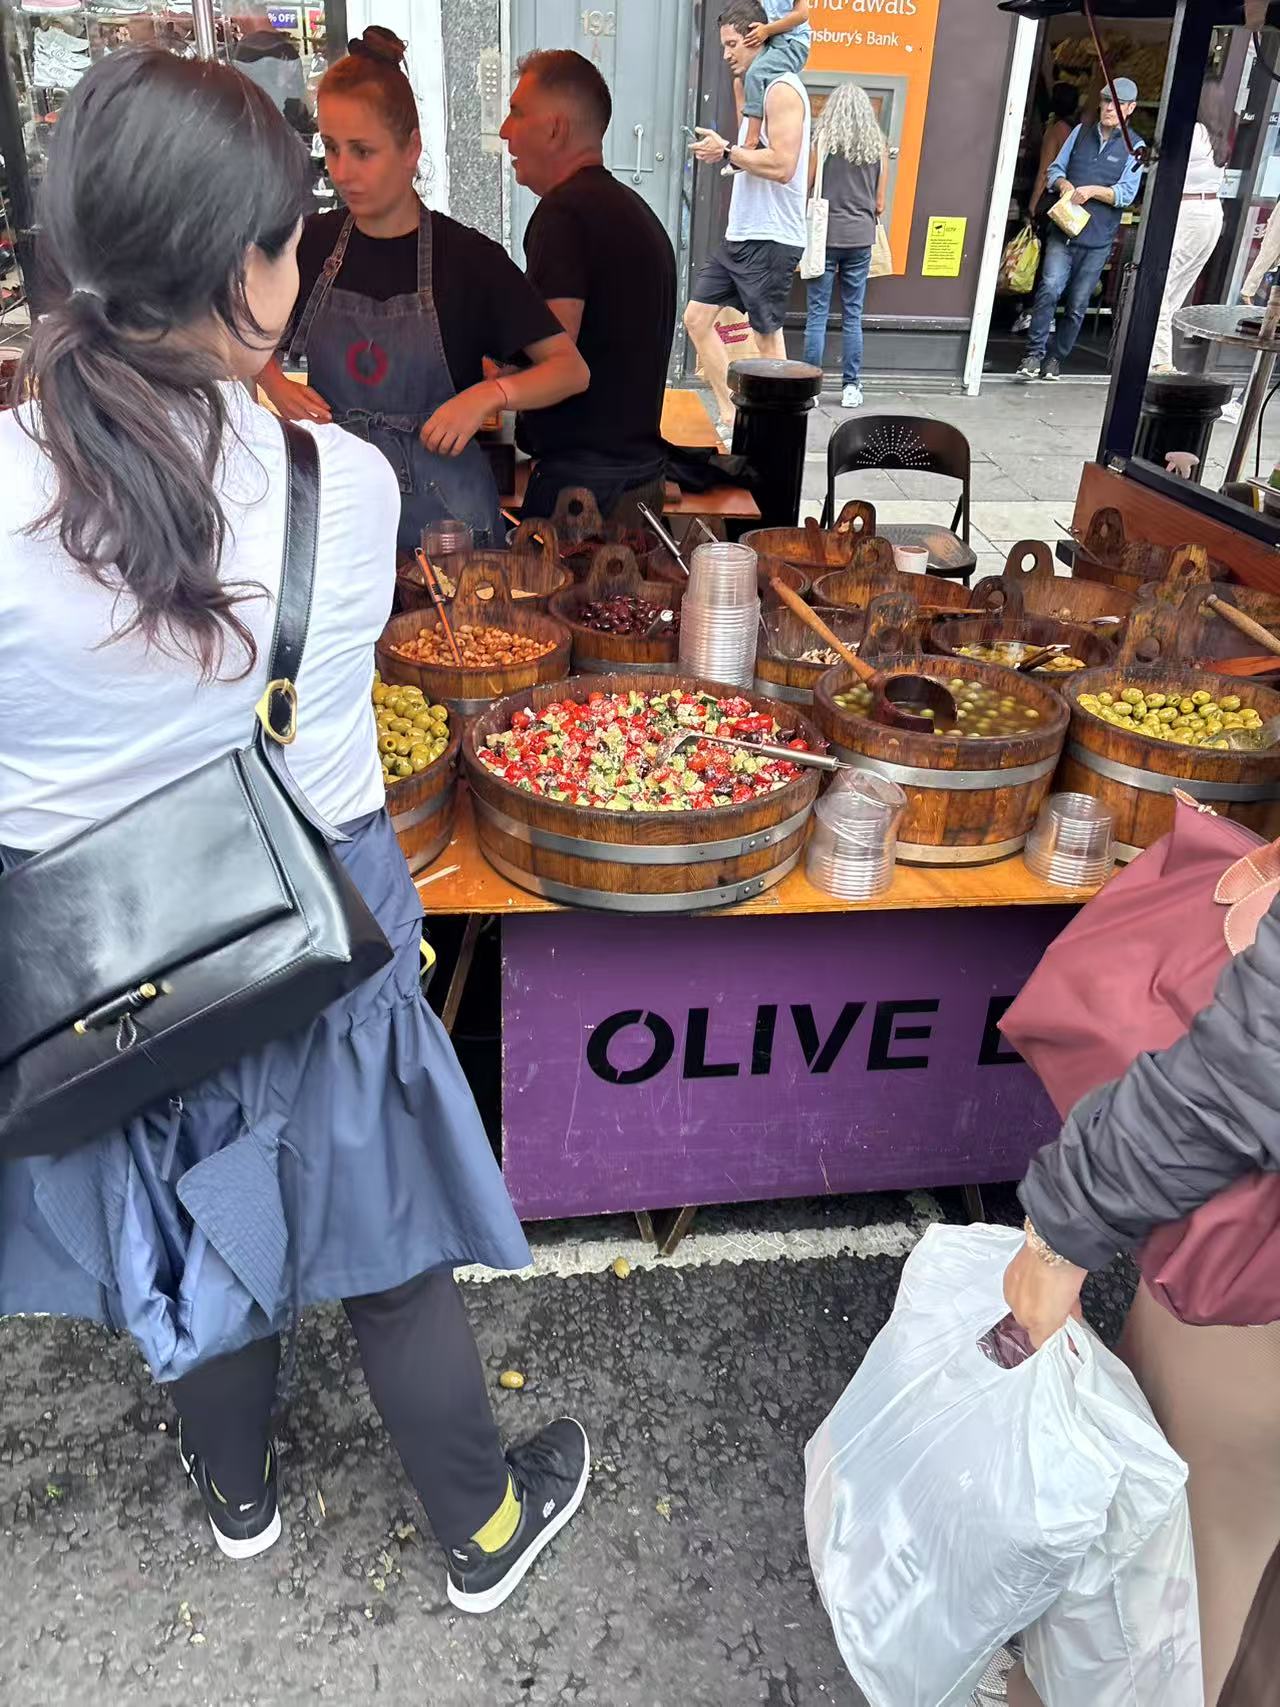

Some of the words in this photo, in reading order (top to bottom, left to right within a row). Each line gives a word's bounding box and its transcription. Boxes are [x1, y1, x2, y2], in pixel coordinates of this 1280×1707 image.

[278, 13, 296, 23] OFF
[809, 29, 863, 47] nsbury's
[867, 31, 899, 46] Bank
[587, 999, 940, 1084] OLIVE
